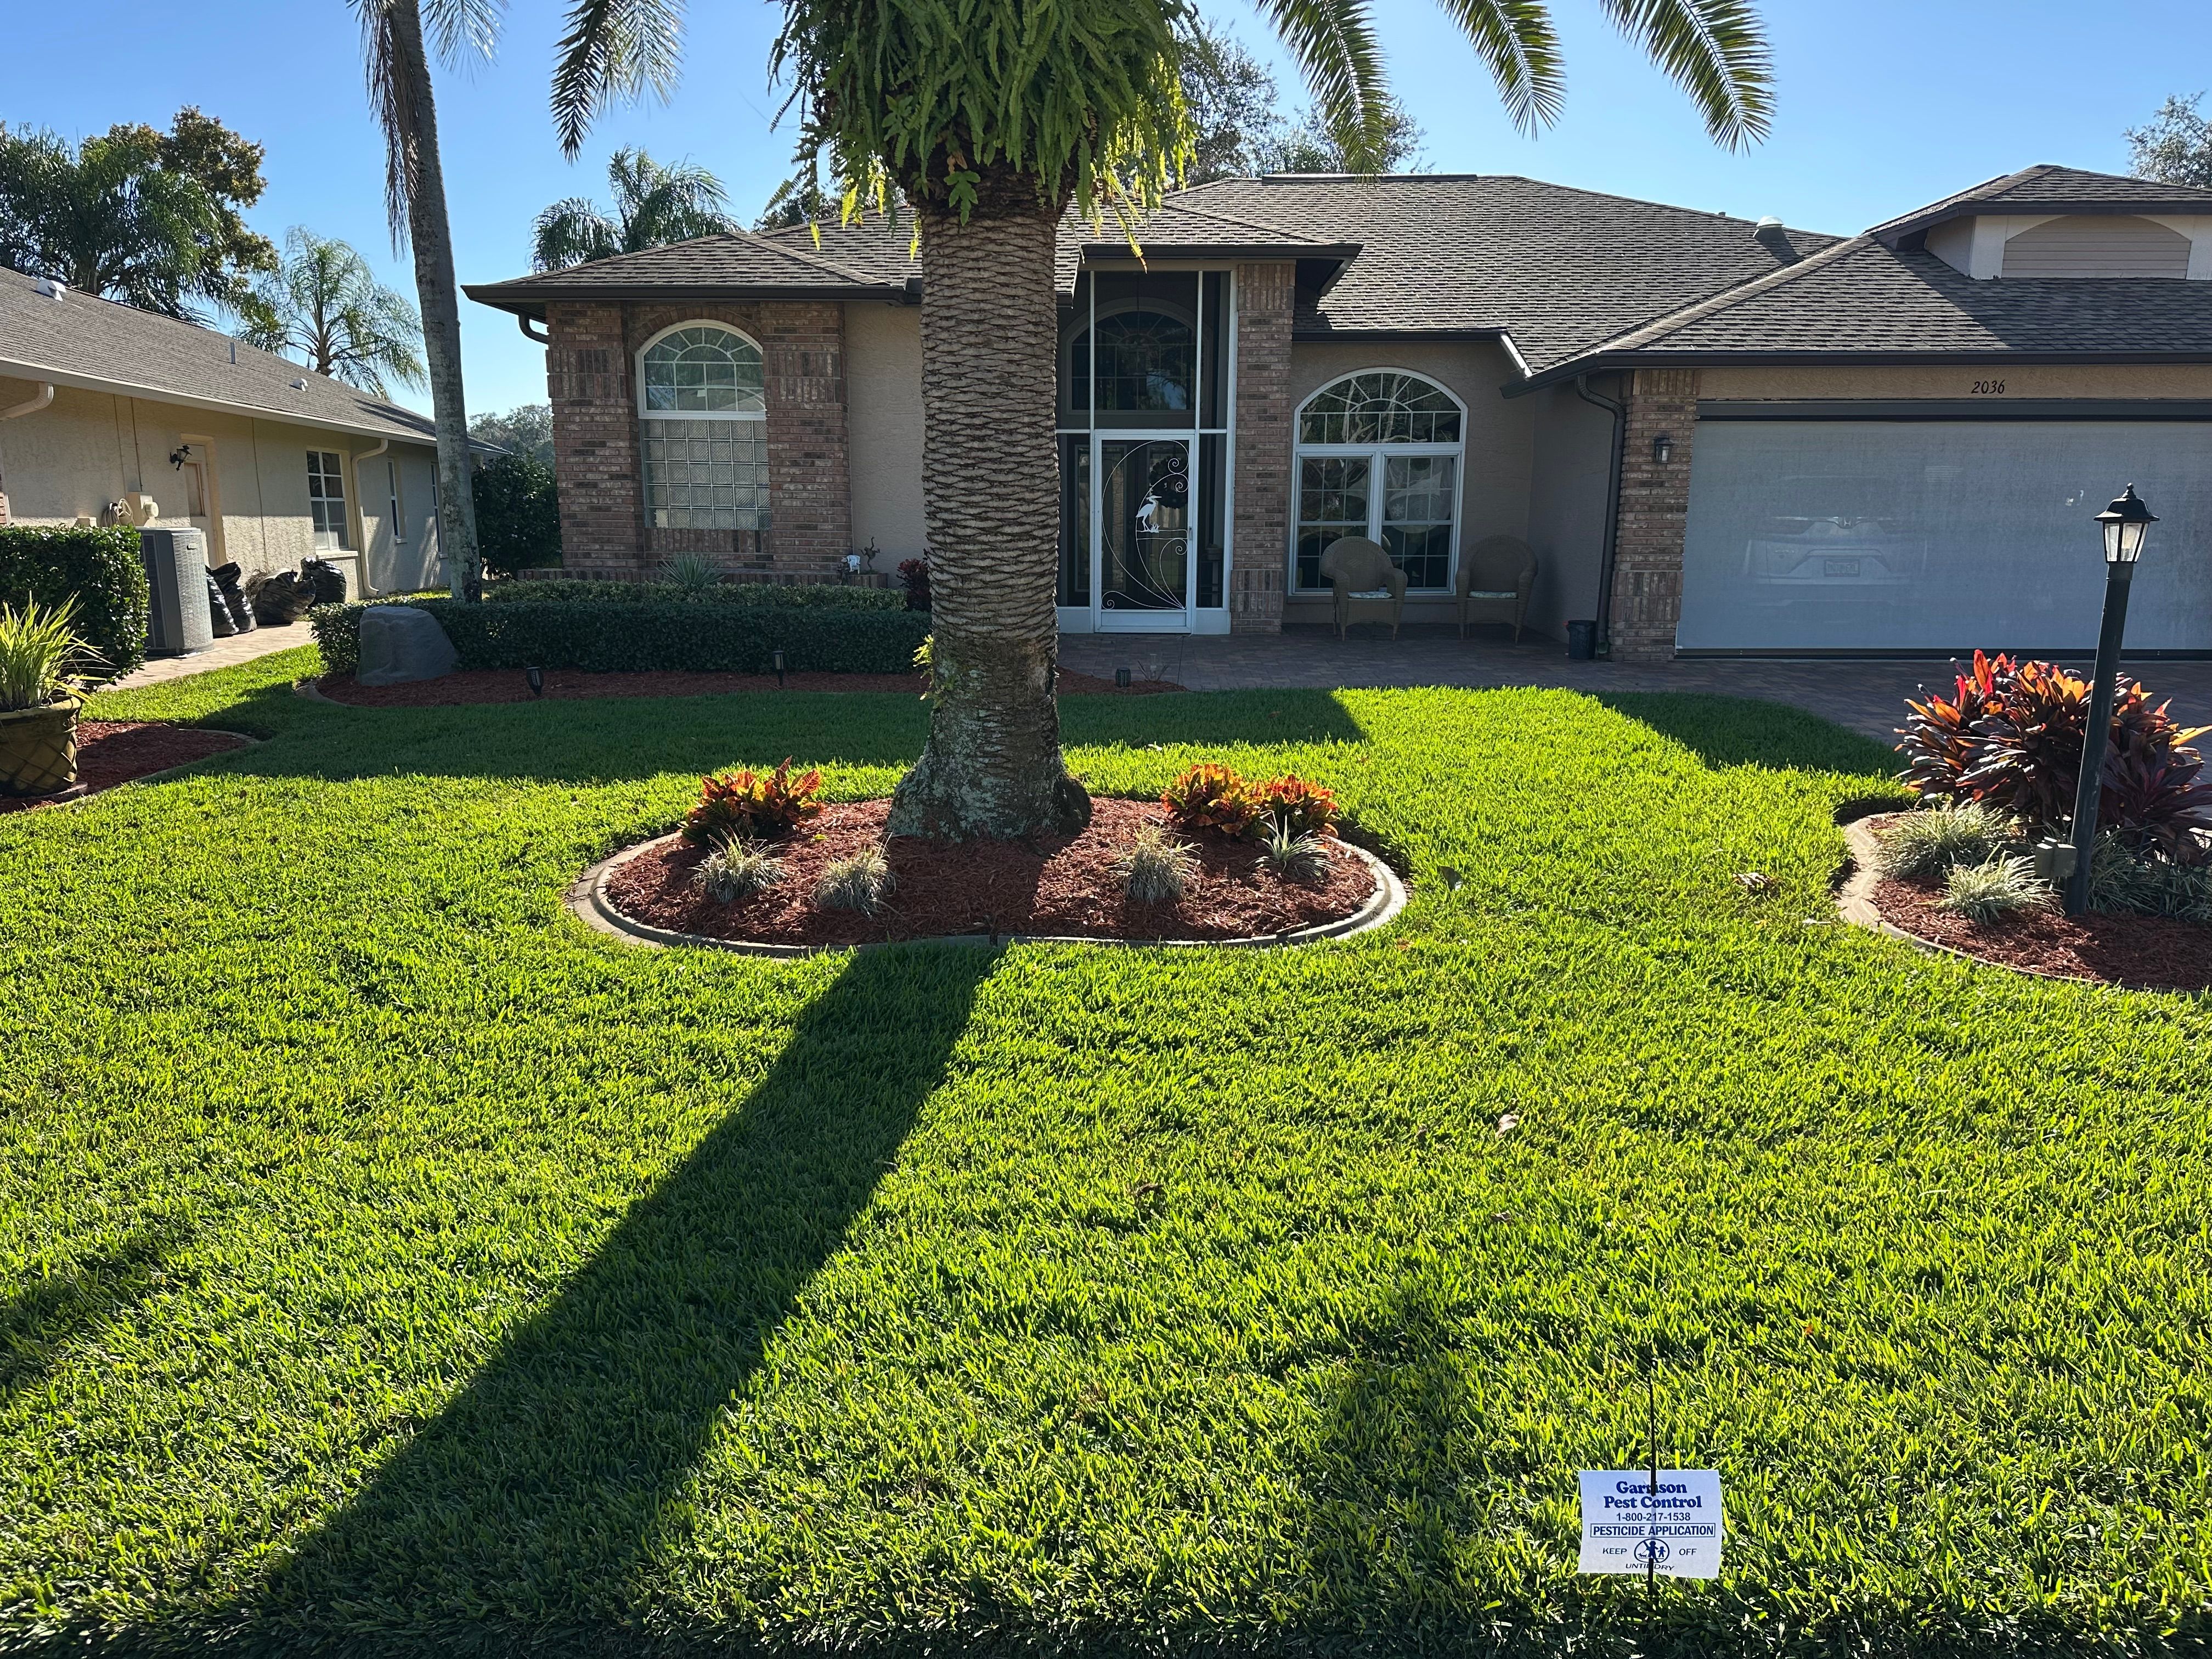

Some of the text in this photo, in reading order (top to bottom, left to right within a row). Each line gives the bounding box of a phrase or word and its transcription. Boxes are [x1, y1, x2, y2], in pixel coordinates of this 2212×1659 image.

[1971, 379, 2005, 394] 2036
[1616, 1481, 1688, 1494] Garrison
[1603, 1496, 1702, 1508] Pest Control
[1616, 1513, 1690, 1521] 1-800-217-1538
[1593, 1526, 1713, 1536] PESTICIDE APPLICATION
